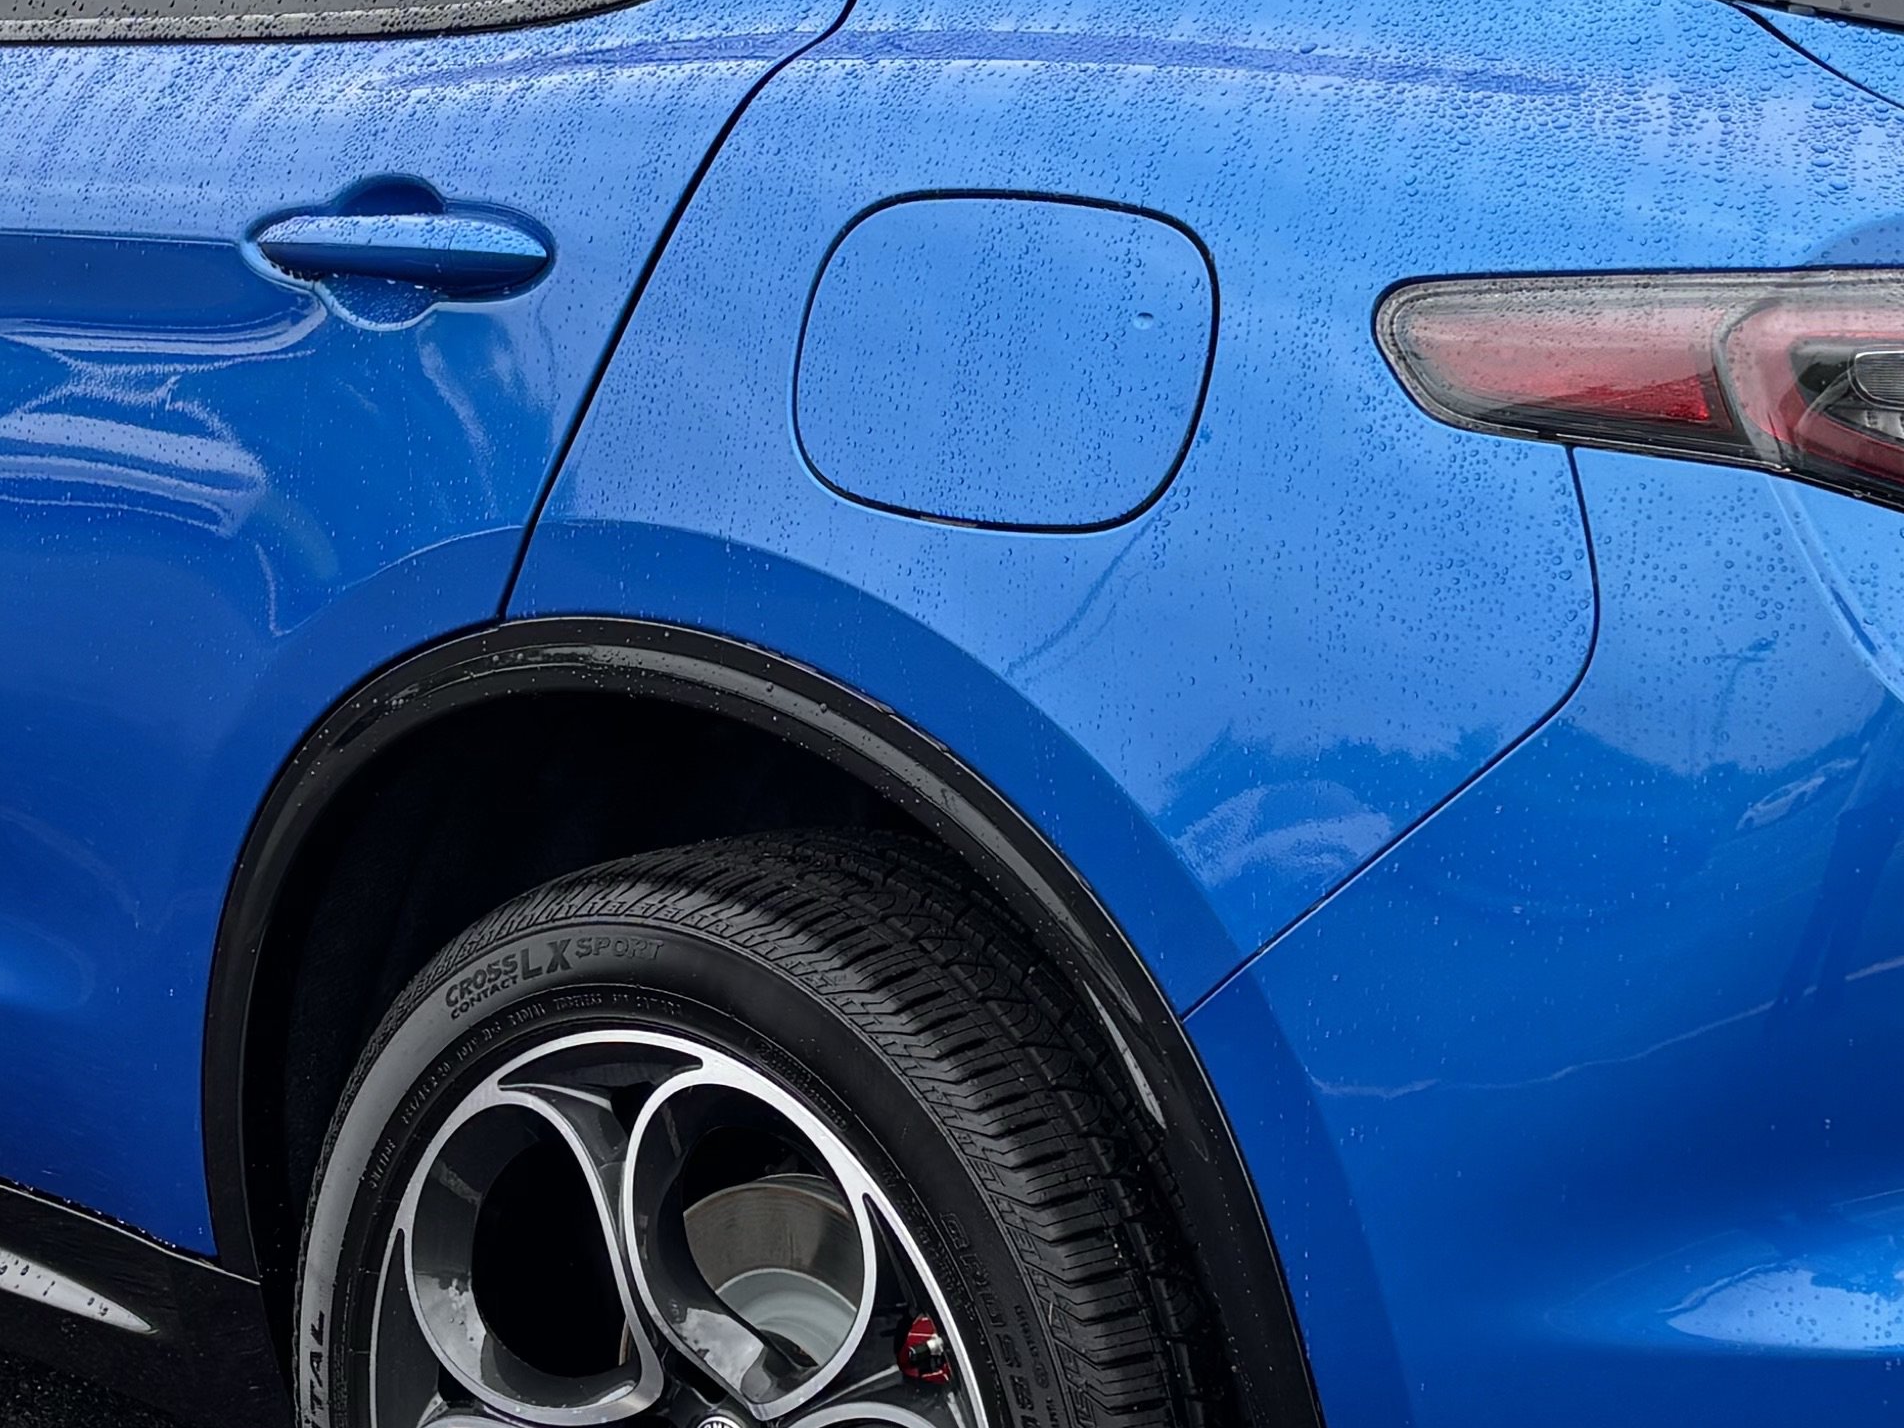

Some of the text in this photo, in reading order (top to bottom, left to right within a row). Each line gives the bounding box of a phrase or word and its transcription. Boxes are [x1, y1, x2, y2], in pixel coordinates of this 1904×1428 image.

[446, 936, 665, 1008] CROSS LX SPORT
[450, 974, 519, 1020] CONTACT
